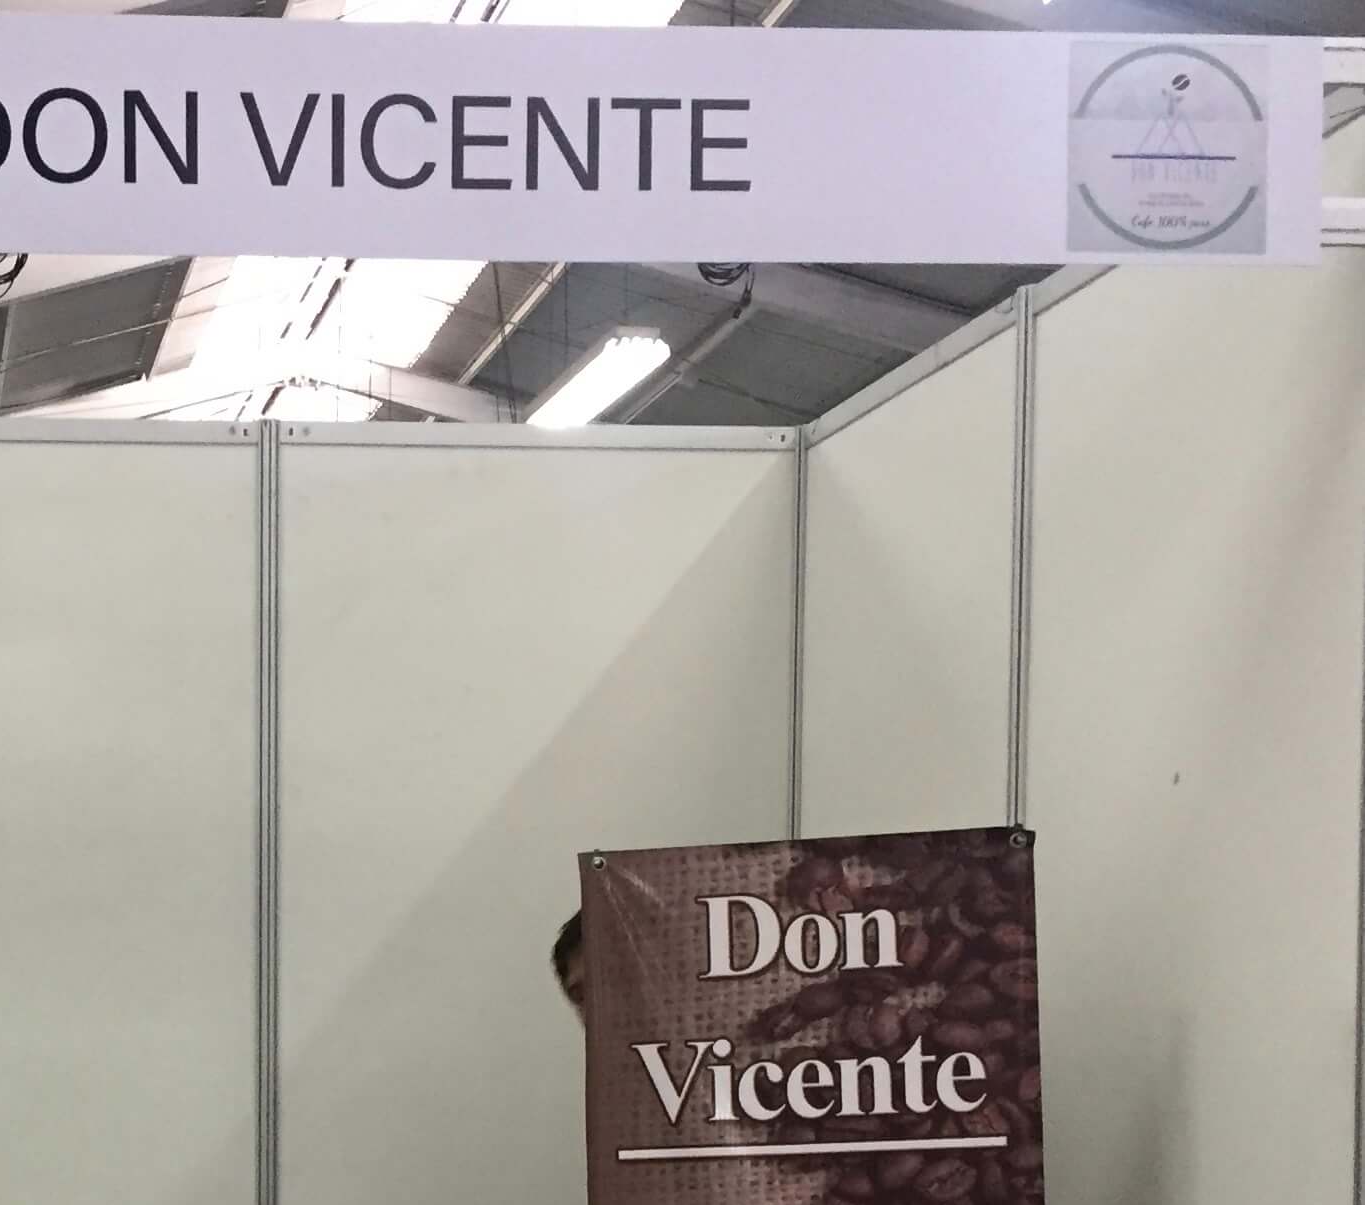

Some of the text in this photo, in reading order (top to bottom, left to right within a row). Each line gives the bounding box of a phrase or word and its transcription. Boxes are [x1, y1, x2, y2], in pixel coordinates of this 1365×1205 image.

[240, 92, 750, 191] VICENTE
[697, 896, 901, 976] Don
[632, 1037, 986, 1121] Vicente
